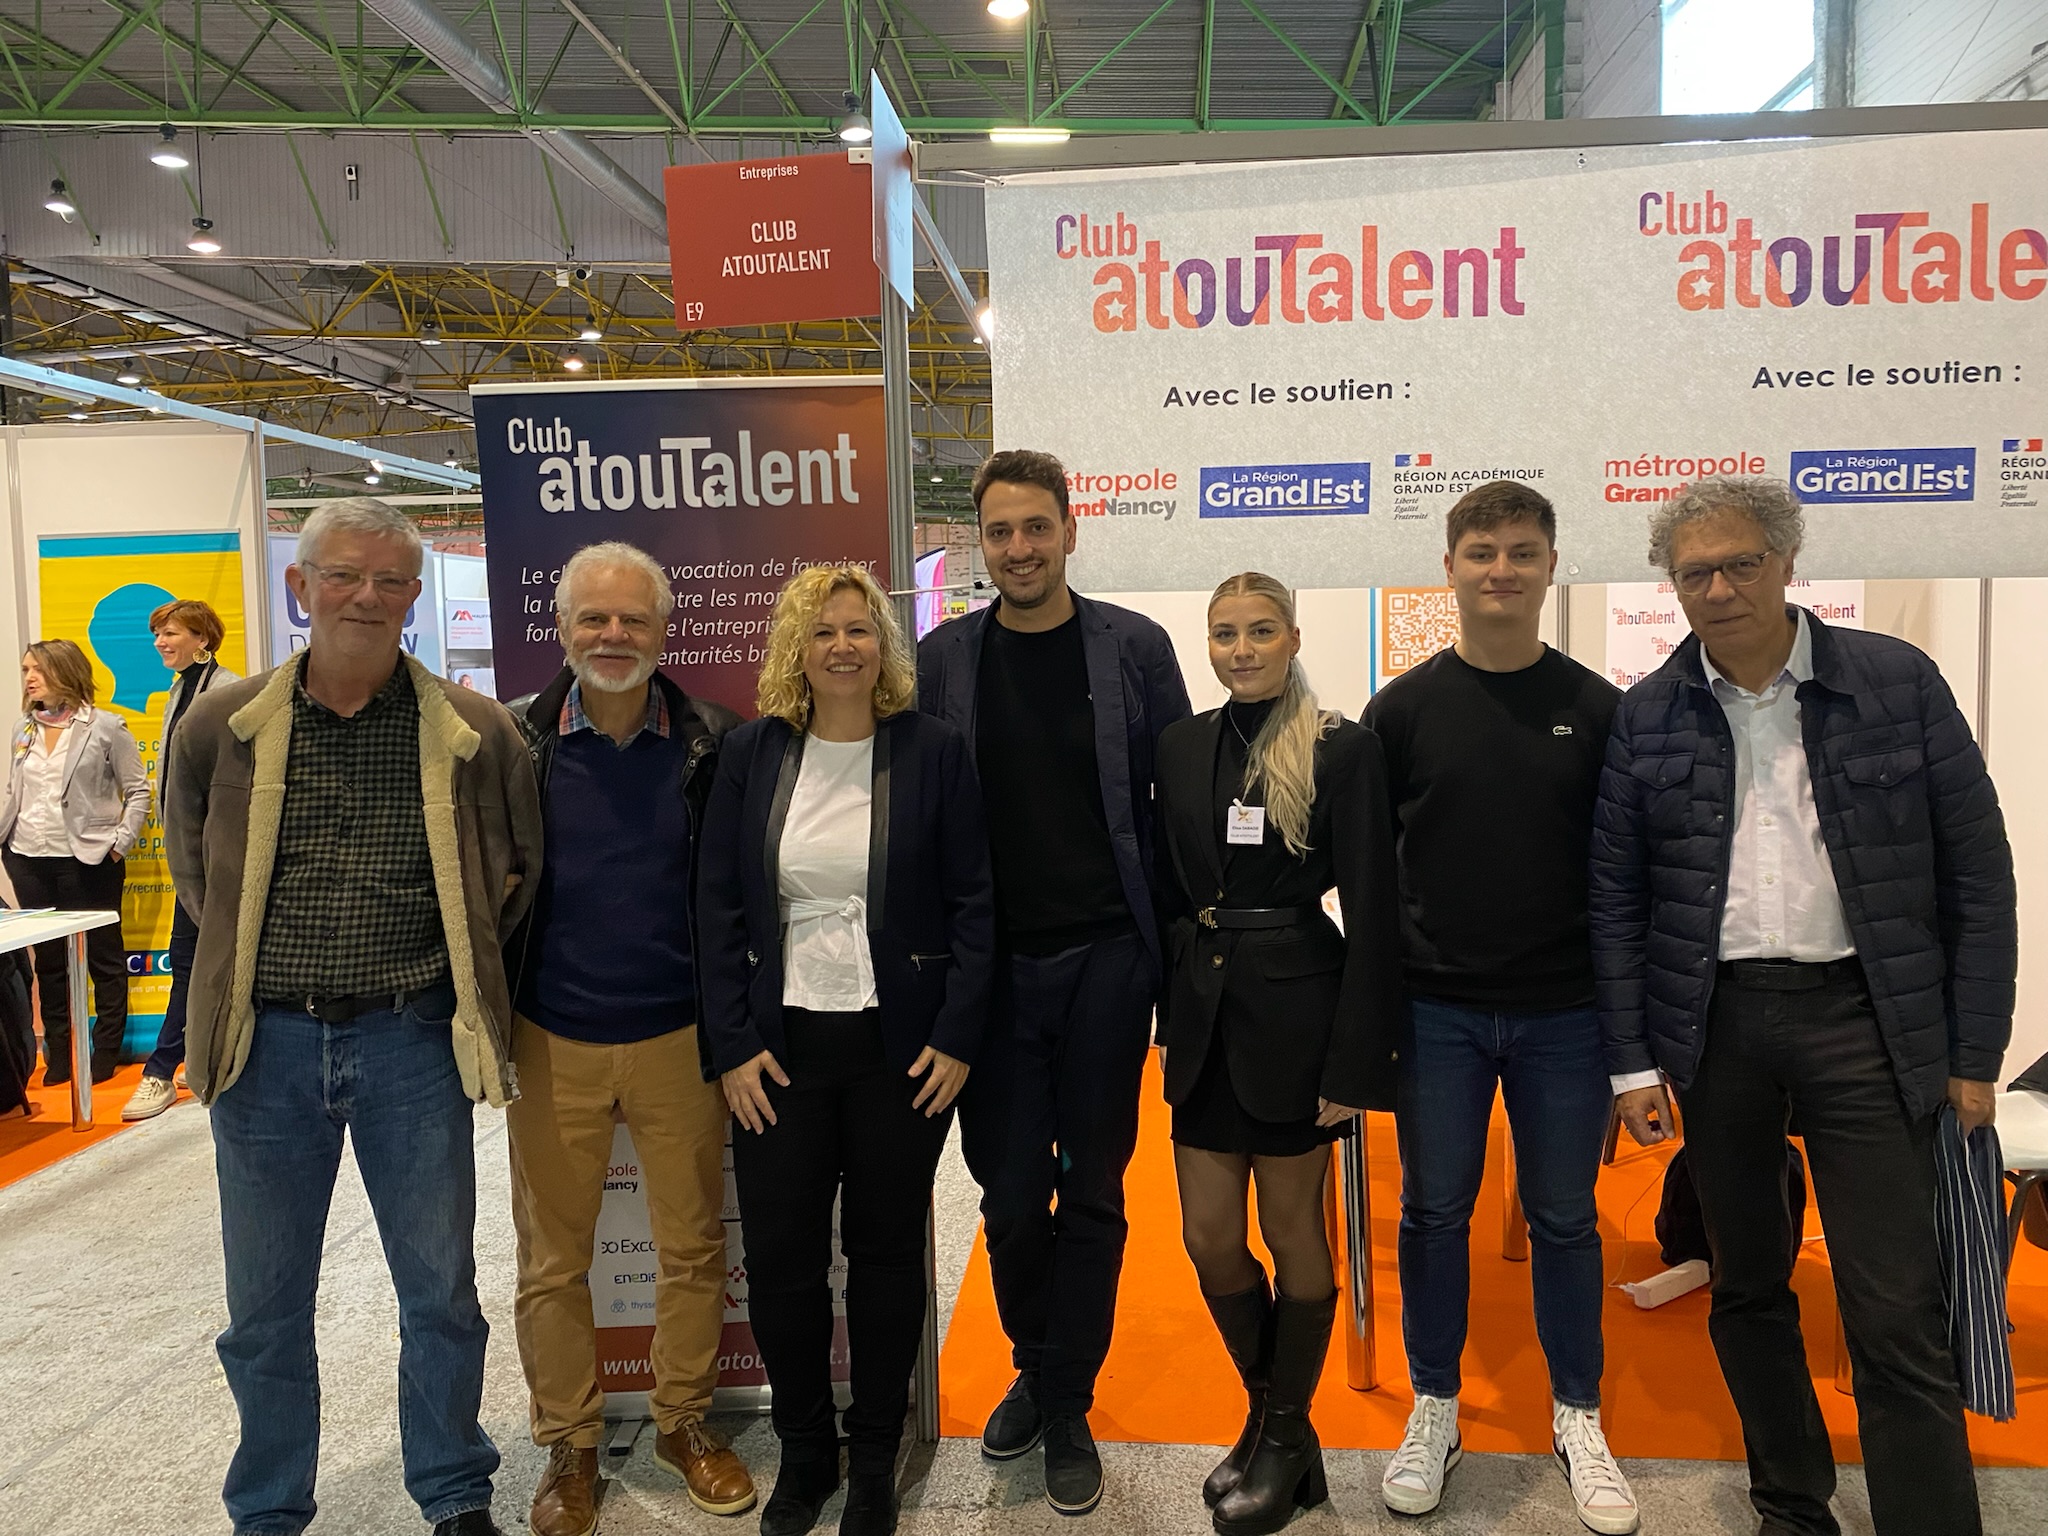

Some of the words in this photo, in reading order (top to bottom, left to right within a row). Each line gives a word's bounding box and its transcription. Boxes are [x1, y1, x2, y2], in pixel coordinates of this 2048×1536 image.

[740, 164, 799, 181] Entreprises
[1639, 190, 1728, 236] Club
[751, 220, 797, 243] CLUB
[1056, 212, 1137, 260] Club
[722, 249, 831, 278] ATOUTALENT
[1677, 203, 2048, 311] atouTale
[1093, 225, 1525, 333] atouTalent
[685, 301, 704, 322] E9
[1752, 367, 1835, 389] Avec
[1848, 364, 1875, 386] le
[1886, 361, 2001, 385] soutien
[1163, 386, 1240, 408] Avec
[1251, 383, 1276, 405] le
[1286, 378, 1393, 404] soutien
[507, 417, 573, 454] Club
[538, 430, 860, 513] atouTalent
[1605, 452, 1766, 480] métropole
[1826, 457, 1843, 468] La
[1848, 456, 1897, 470] Région
[2001, 455, 2047, 468] RÉGIO
[1065, 467, 1177, 497] étropole
[1233, 472, 1249, 483] La
[1252, 471, 1298, 484] Région
[1394, 470, 1447, 482] RÉGION
[1451, 468, 1545, 481] ACADÉMIQUE
[2001, 470, 2048, 480] GRAN
[1393, 484, 1445, 494] GRAND
[1449, 483, 1472, 493] EST
[1604, 482, 1689, 503] Grand
[1067, 498, 1176, 521] andNancy
[521, 567, 543, 585] Le
[550, 565, 566, 584] cl
[671, 560, 754, 580] vocation
[761, 558, 784, 577] de
[523, 595, 542, 614] la
[673, 593, 703, 609] tre
[710, 588, 737, 608] les
[1811, 603, 1856, 619] Talent
[681, 616, 776, 639] l'entrepris
[1617, 610, 1676, 625] atouTalent
[658, 644, 742, 666] entarités
[126, 953, 172, 973] CIC
